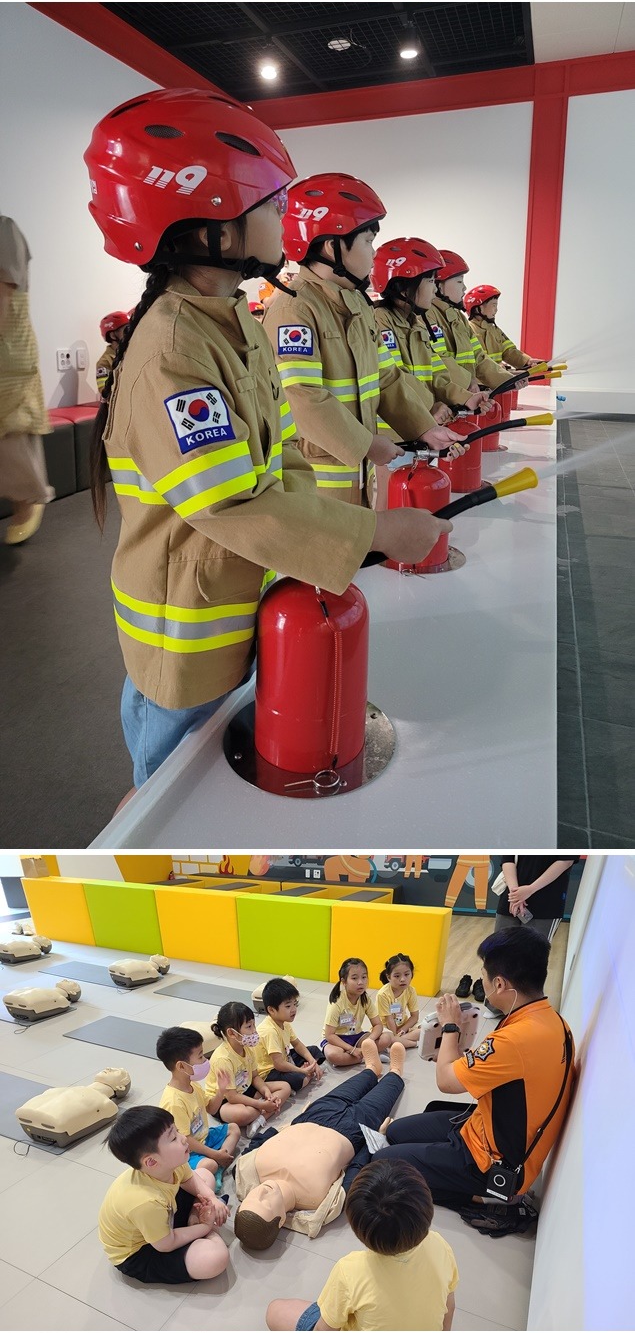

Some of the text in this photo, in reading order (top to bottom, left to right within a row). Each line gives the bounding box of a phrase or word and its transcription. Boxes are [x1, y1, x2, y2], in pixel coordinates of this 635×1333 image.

[143, 165, 208, 195] 119
[299, 206, 329, 222] 119
[386, 256, 407, 267] 119
[185, 427, 228, 446] KOREA
